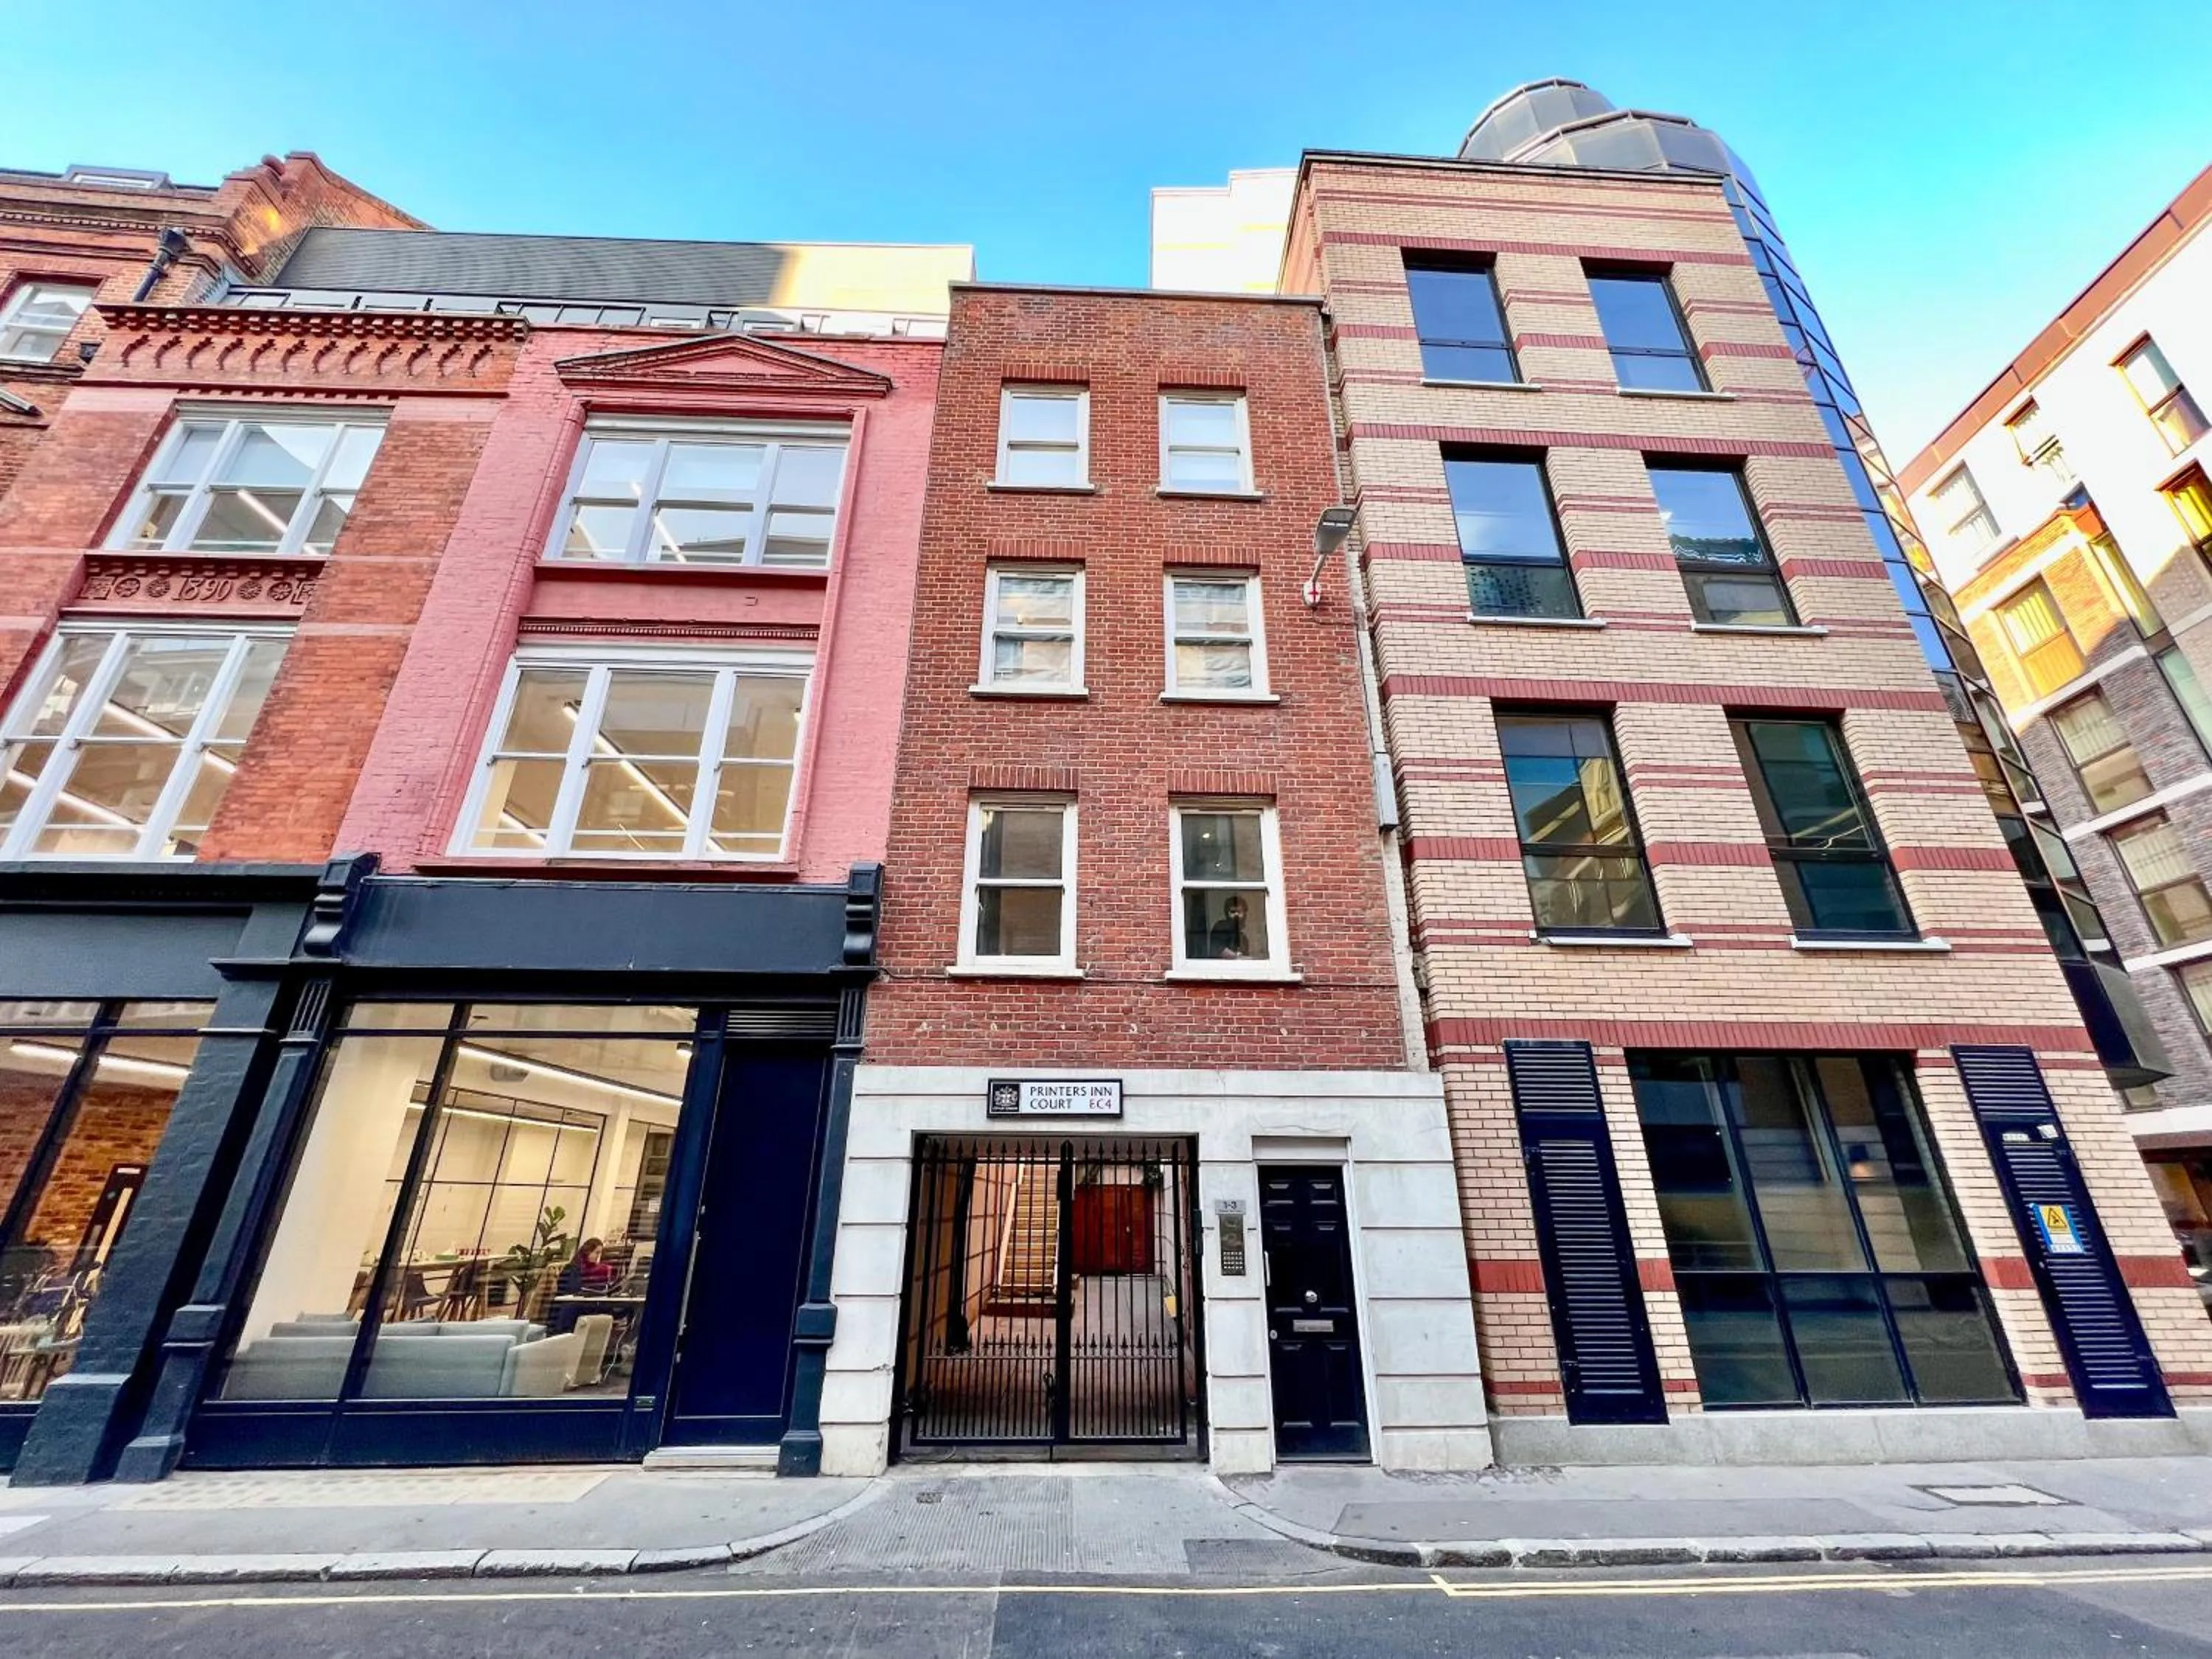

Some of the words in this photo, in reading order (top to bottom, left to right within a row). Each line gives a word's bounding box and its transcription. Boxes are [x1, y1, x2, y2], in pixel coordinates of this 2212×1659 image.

[173, 577, 234, 601] 1890
[1030, 1086, 1087, 1096] PRINTERS
[1091, 1087, 1112, 1097] INN
[1030, 1099, 1072, 1110] COURT
[1089, 1099, 1112, 1109] EC4
[1223, 1200, 1237, 1210] 1-3
